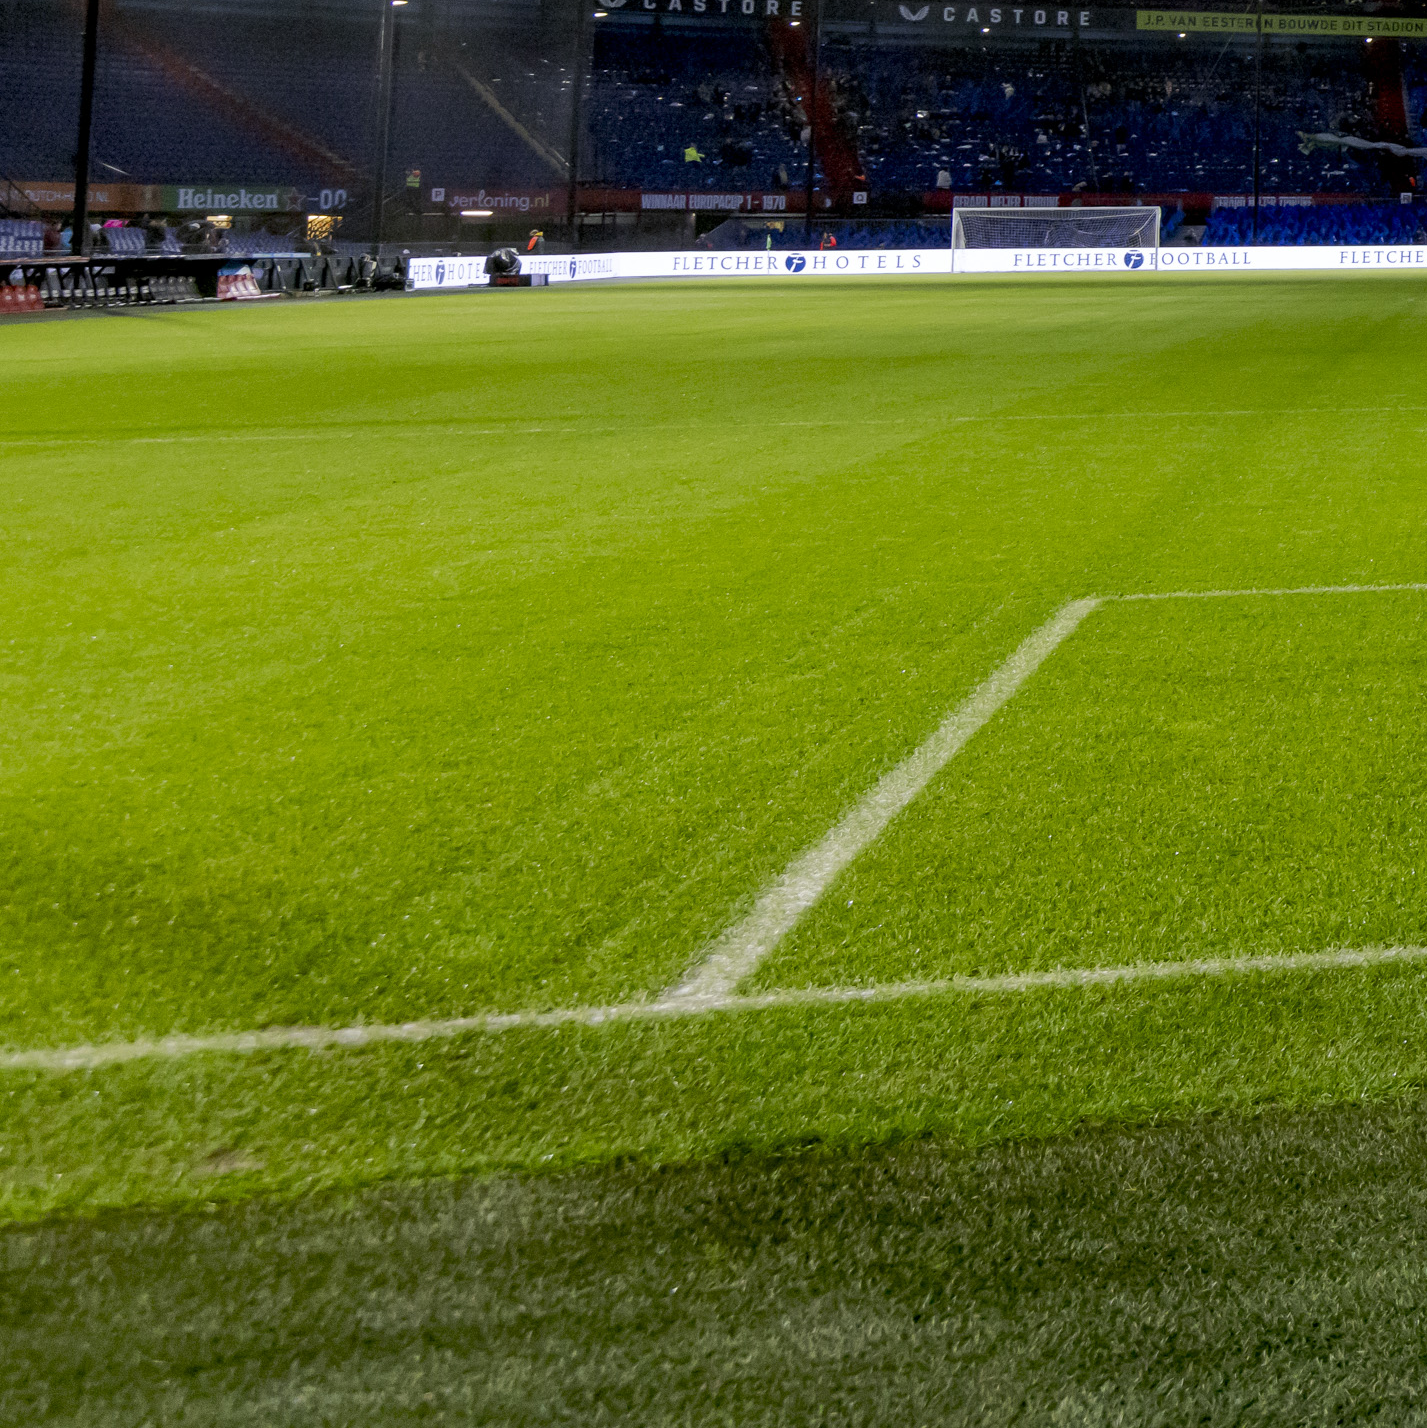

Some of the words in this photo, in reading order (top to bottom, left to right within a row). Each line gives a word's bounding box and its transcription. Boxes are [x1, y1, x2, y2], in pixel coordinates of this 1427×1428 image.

[943, 7, 1090, 26] CASTORE
[1169, 16, 1196, 26] VAN
[1279, 19, 1337, 30] BOUWDE
[1343, 20, 1363, 31] DIT
[1366, 21, 1423, 32] STADION
[177, 188, 278, 209] Heineken
[641, 194, 686, 209] WINNAAR
[689, 194, 744, 209] EUROPACUP
[762, 195, 786, 210] 1970
[529, 259, 568, 276] FLETCHER
[575, 258, 613, 275] FOOTBALL
[673, 256, 779, 271] FLETCHER
[813, 254, 922, 270] HOTELS
[1013, 253, 1118, 267] FLETCHER
[1149, 252, 1251, 266] FOOTBALL
